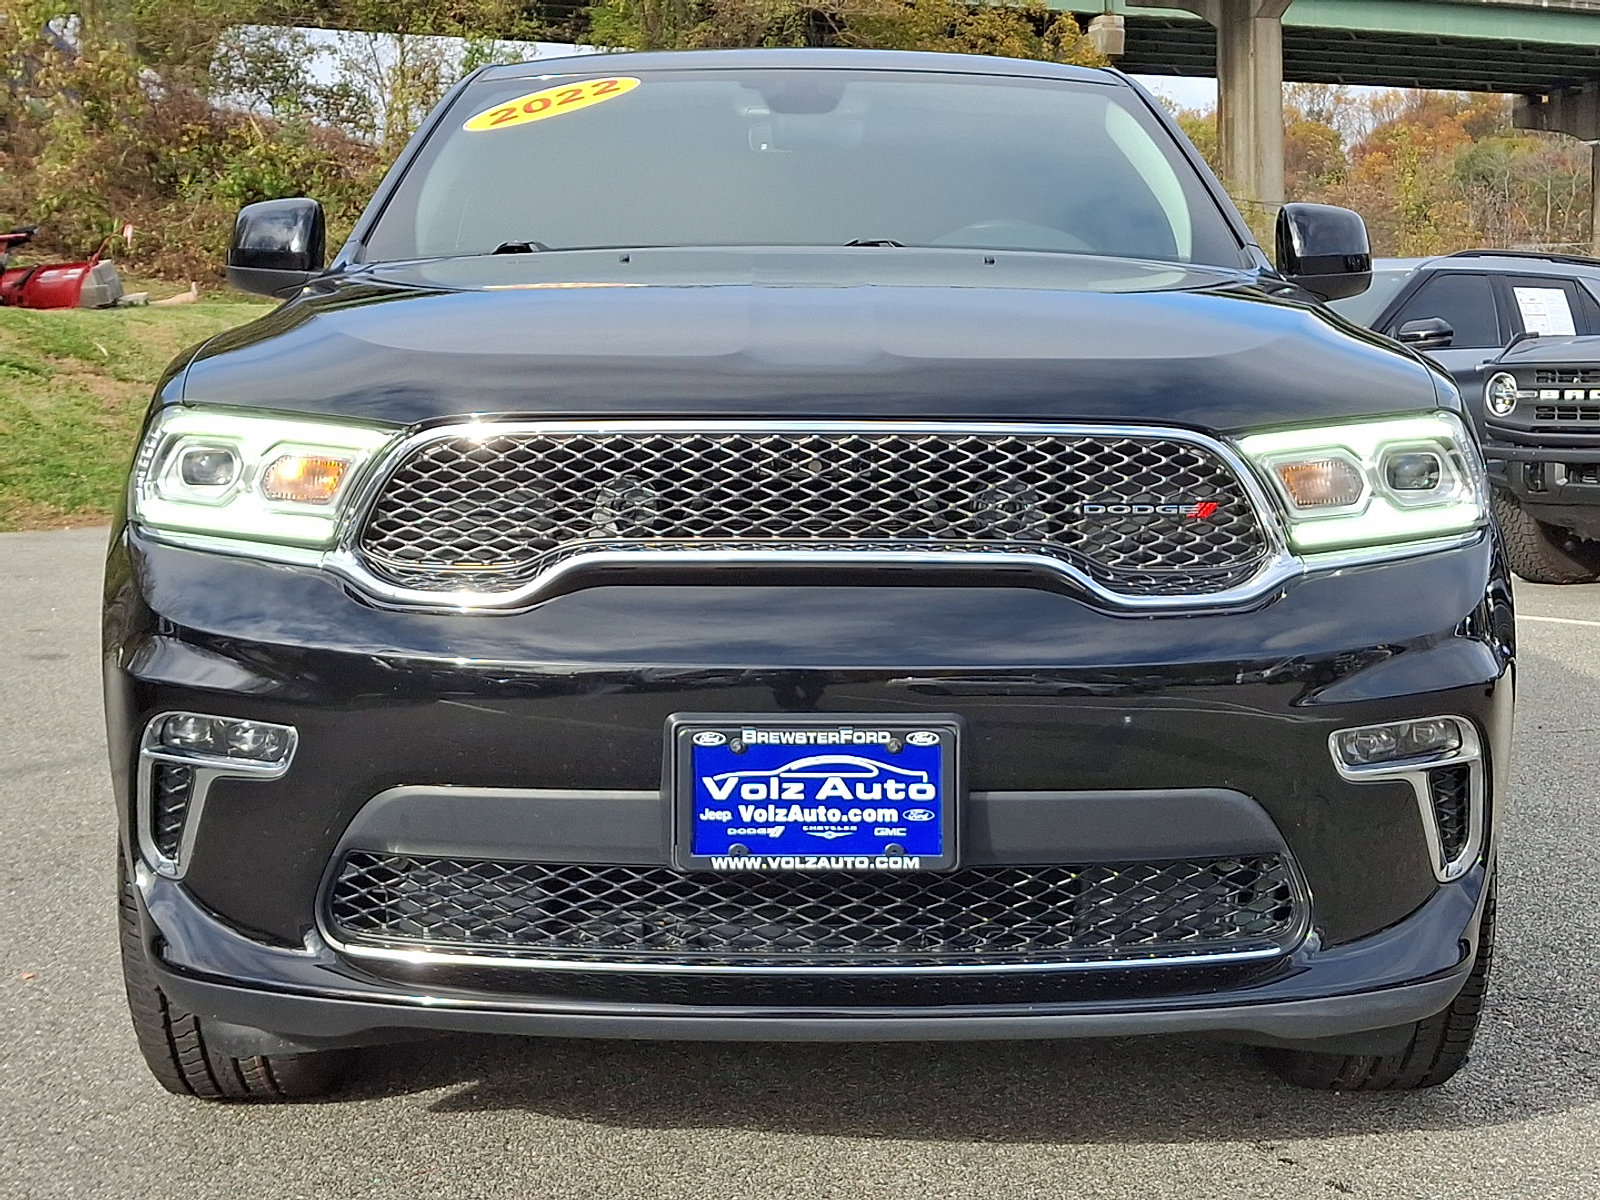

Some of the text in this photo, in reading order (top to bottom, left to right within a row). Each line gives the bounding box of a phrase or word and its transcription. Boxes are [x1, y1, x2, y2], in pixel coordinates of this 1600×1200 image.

[489, 80, 621, 126] 2022
[1083, 504, 1199, 515] DODGE
[702, 776, 936, 800] Volz Auto
[699, 808, 733, 822] Jeep
[738, 804, 898, 823] VolzAuto.com
[873, 827, 907, 837] GMC
[711, 856, 920, 869] WWW.VOLZAUTO.COM
